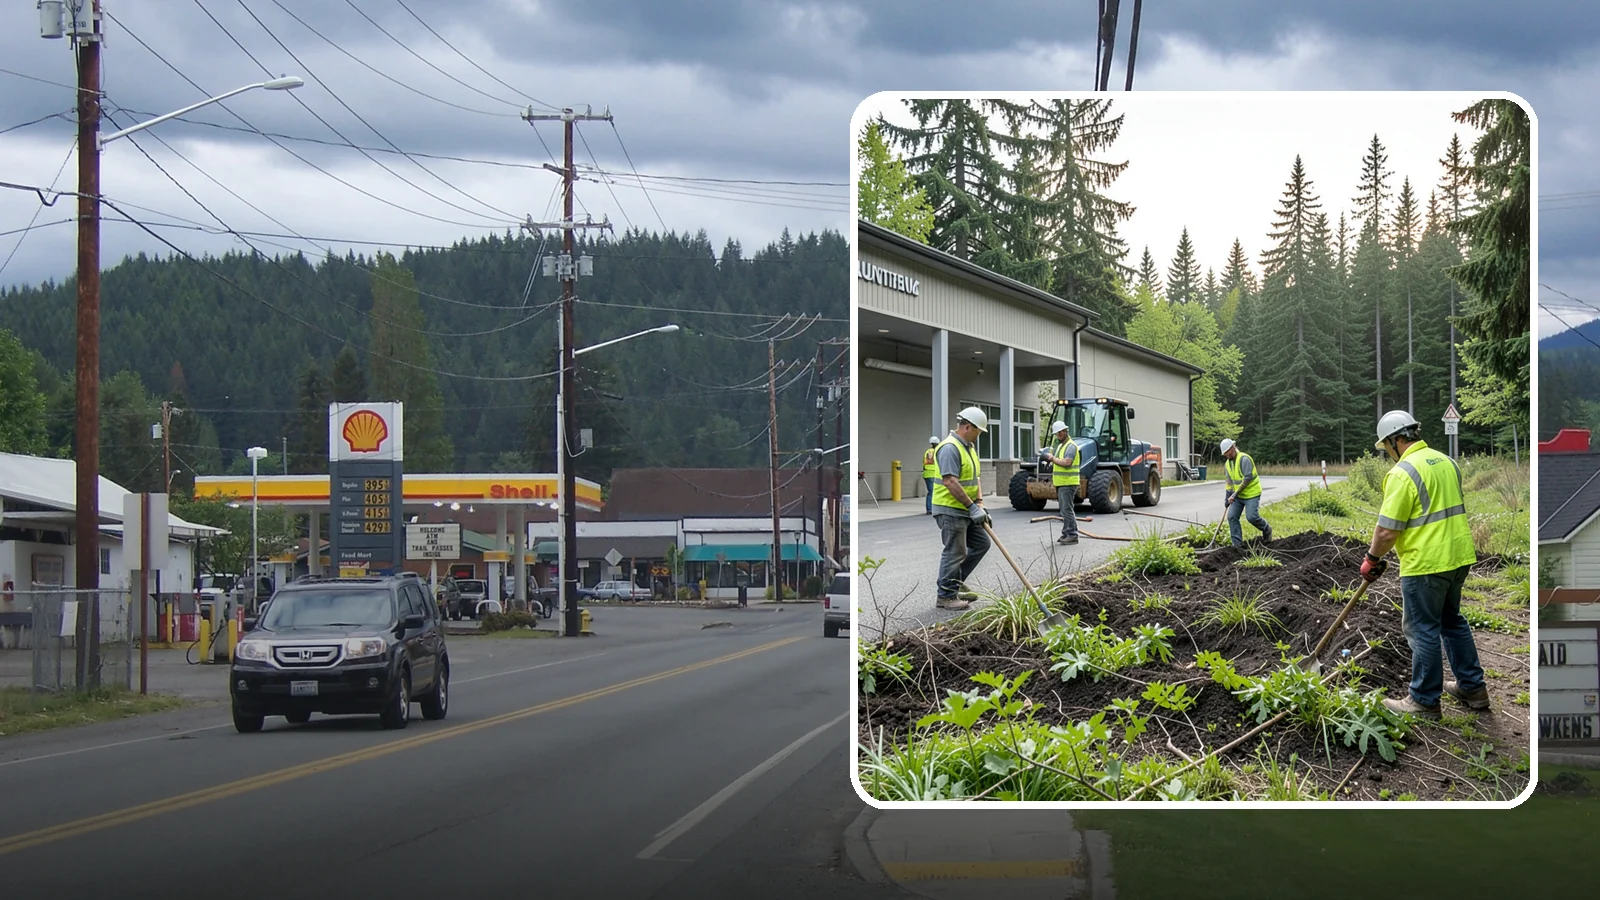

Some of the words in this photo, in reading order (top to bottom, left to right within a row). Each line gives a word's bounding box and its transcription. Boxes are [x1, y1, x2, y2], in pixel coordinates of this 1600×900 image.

[365, 480, 384, 490] 395
[490, 484, 547, 499] Shell
[365, 494, 384, 504] 405
[365, 508, 384, 518] 415
[365, 522, 384, 532] 429
[1538, 643, 1567, 665] AID
[1538, 716, 1592, 739] WKENS
